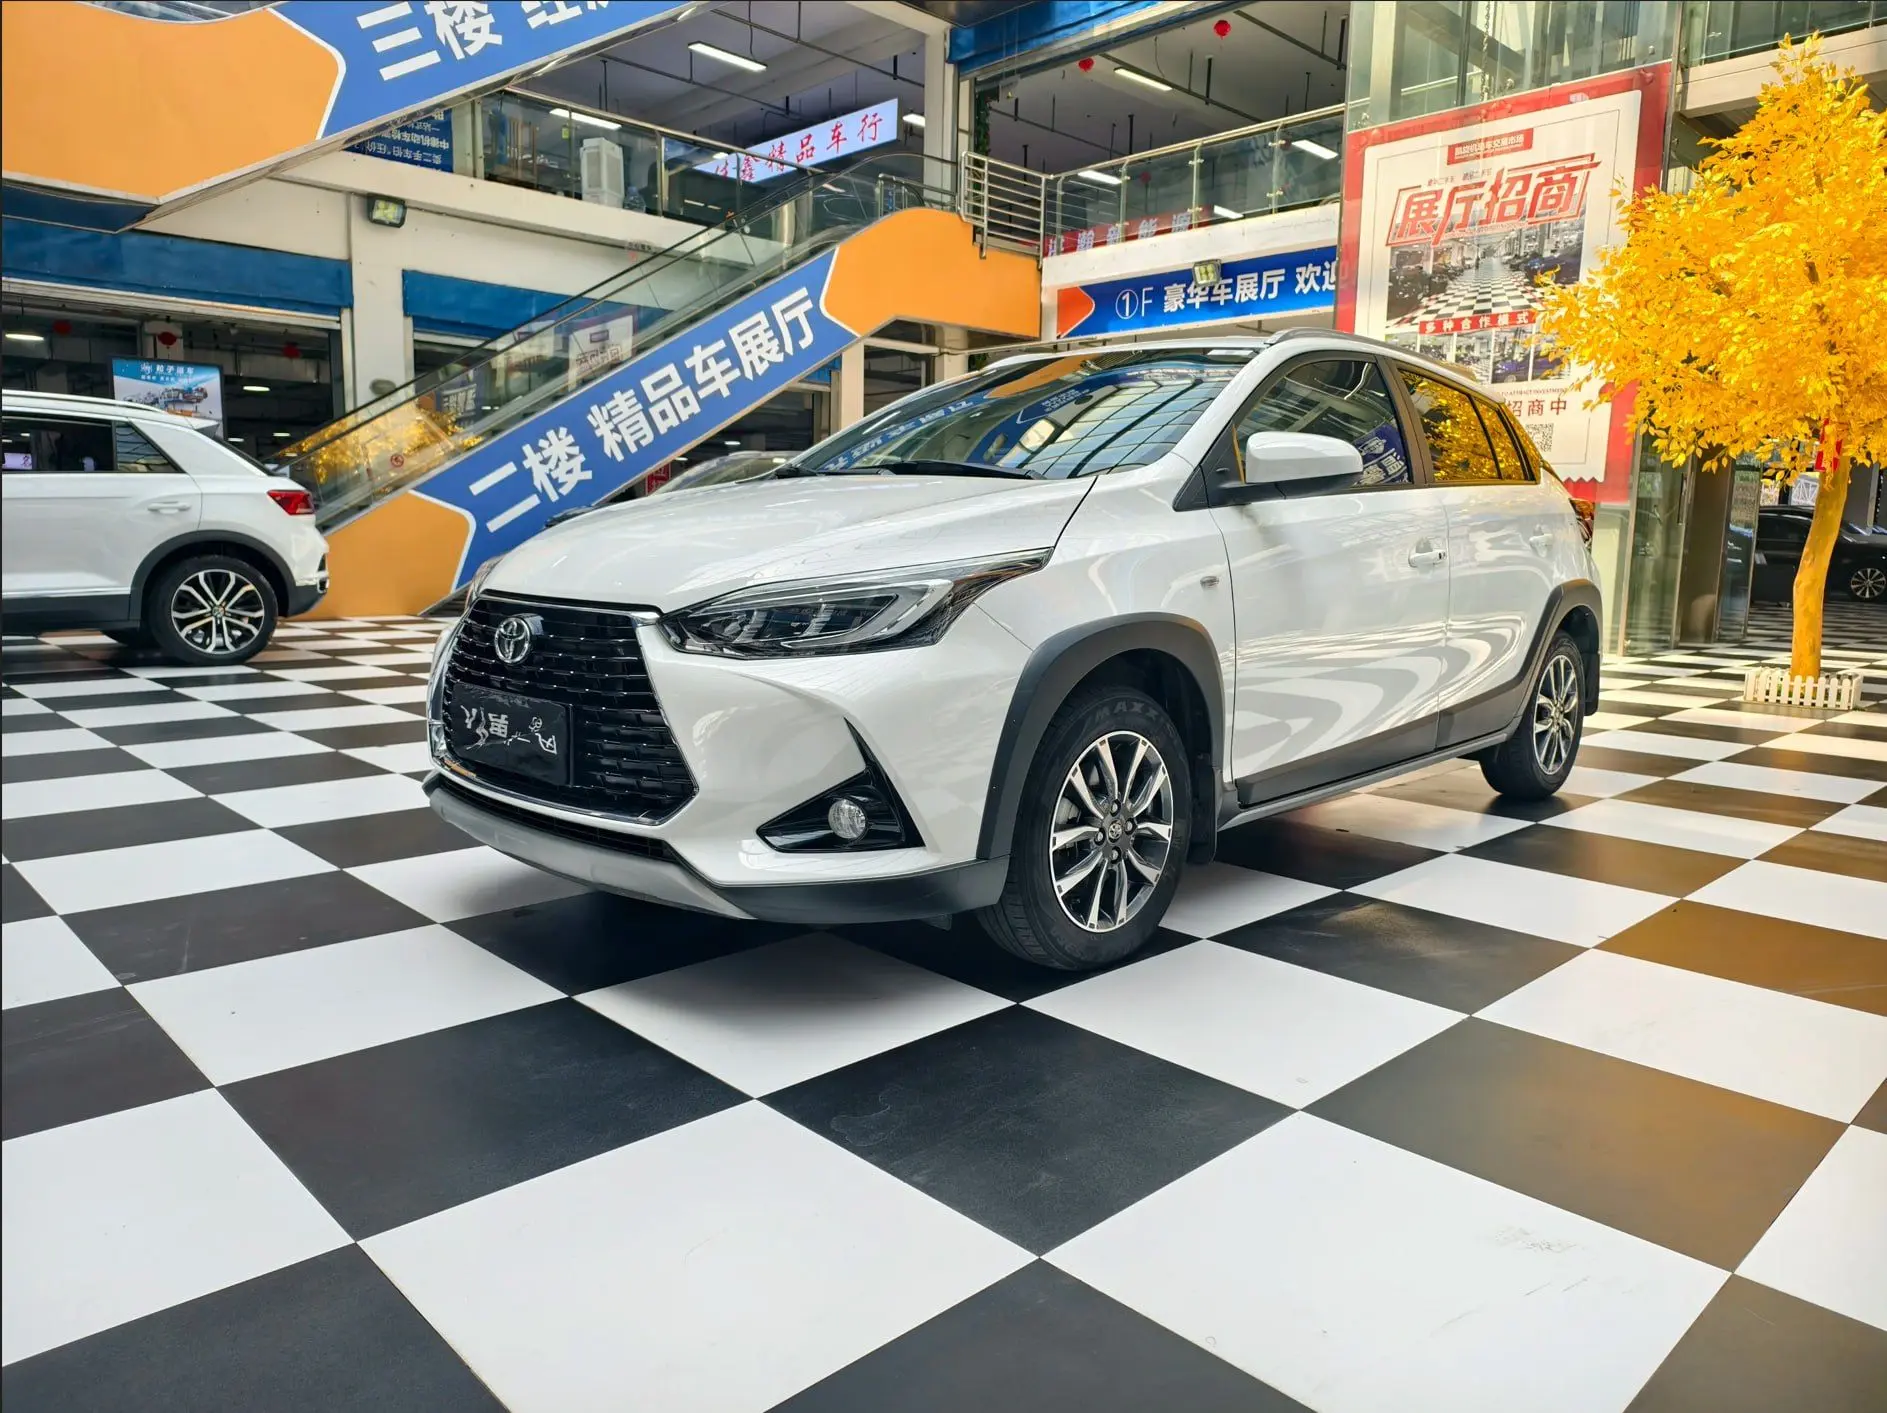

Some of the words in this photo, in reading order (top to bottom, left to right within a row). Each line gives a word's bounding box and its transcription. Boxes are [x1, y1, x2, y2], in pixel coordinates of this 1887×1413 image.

[356, 1, 503, 81] 三楼
[1396, 160, 1601, 246] 展厅招商
[1163, 268, 1286, 313] 豪华车展厅
[1425, 310, 1529, 334] 多种合作模式
[468, 425, 593, 533] 二楼
[586, 287, 814, 462] 精品车展厅
